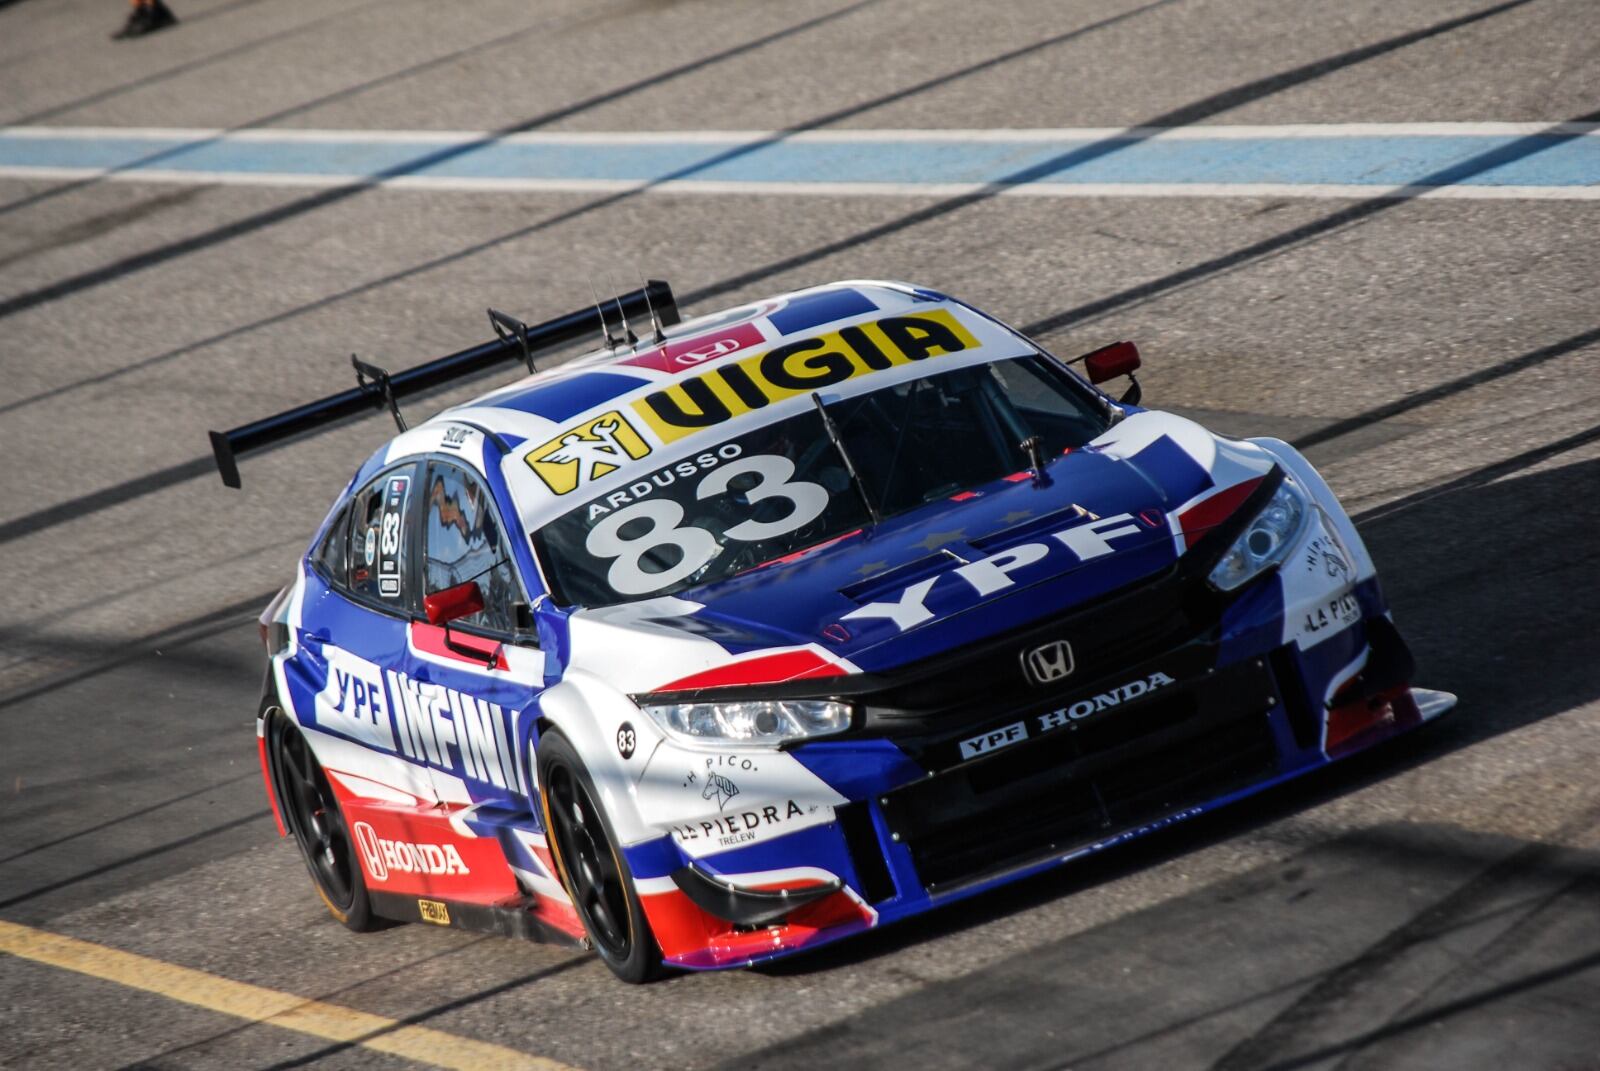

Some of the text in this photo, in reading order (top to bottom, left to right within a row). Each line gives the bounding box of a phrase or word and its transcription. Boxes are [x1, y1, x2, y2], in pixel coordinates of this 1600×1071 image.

[588, 443, 742, 520] ARDUSSO
[381, 512, 400, 555] 83
[586, 454, 830, 595] 83
[839, 512, 1142, 631] YPF
[333, 667, 382, 726] YPF
[967, 671, 1176, 752] YPF HONDA
[618, 730, 636, 752] 83
[700, 800, 804, 838] PIEDRA
[719, 831, 756, 847] TRELEW
[378, 838, 471, 875] HONDA
